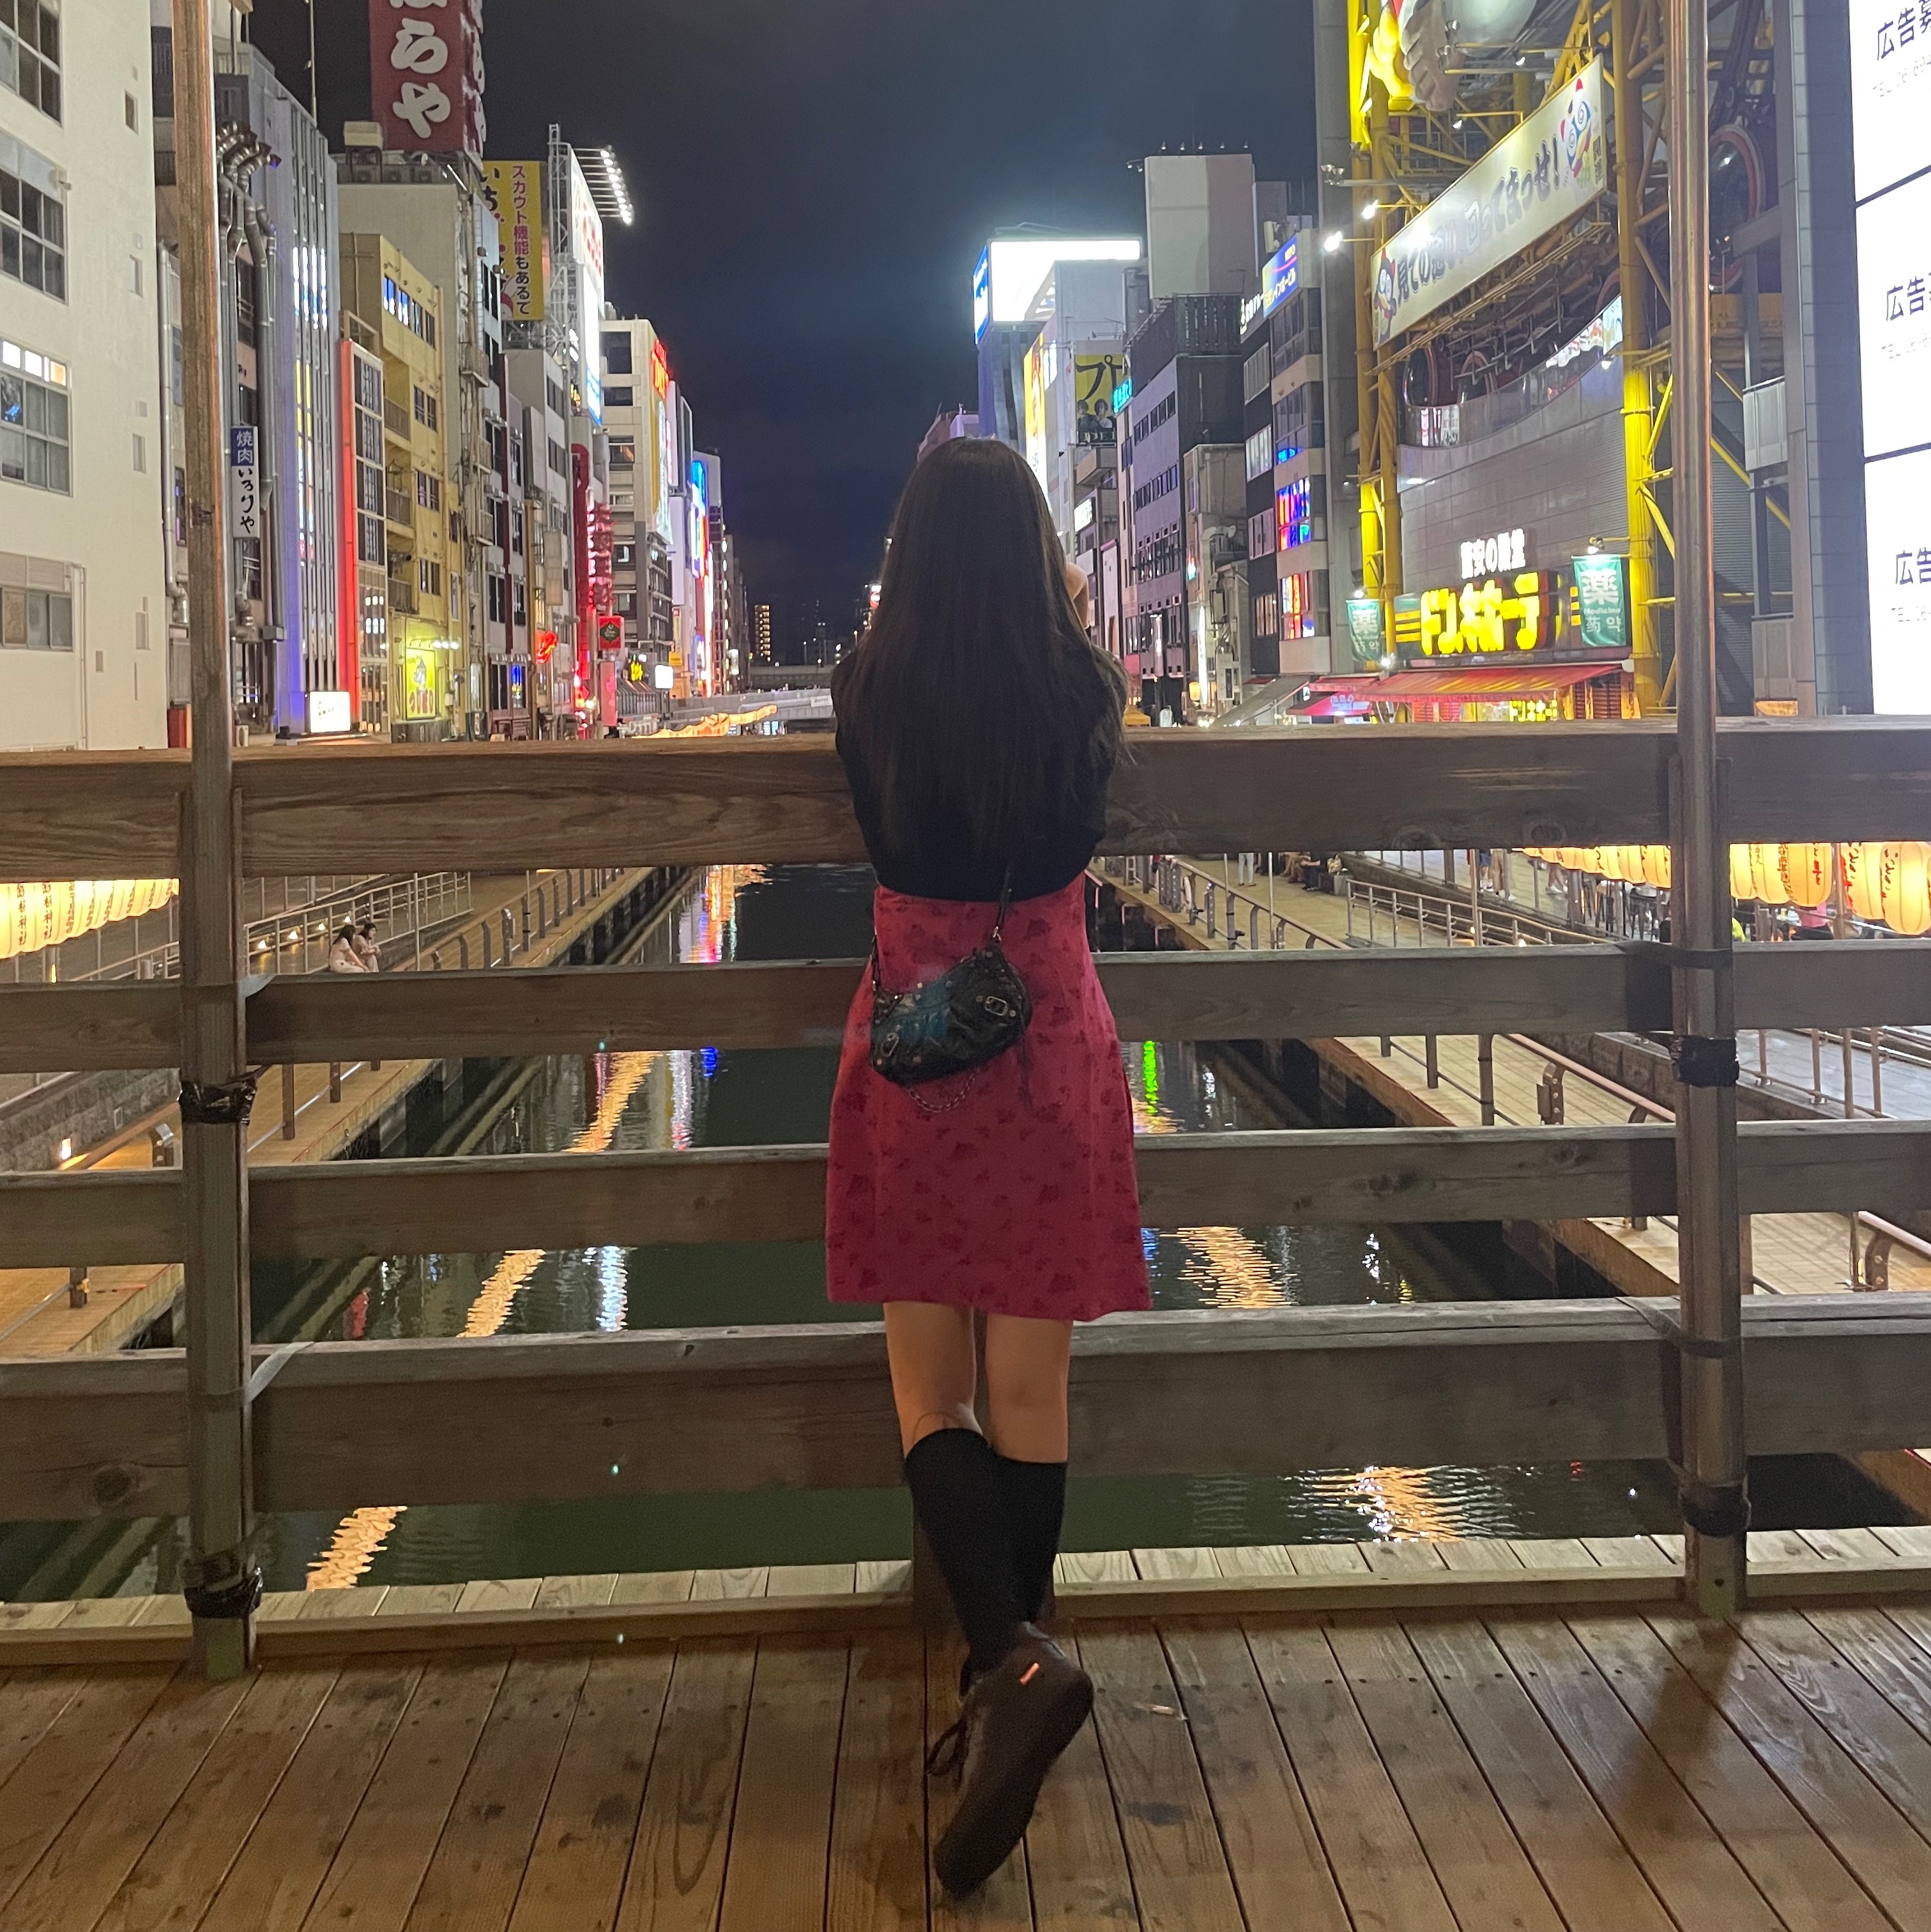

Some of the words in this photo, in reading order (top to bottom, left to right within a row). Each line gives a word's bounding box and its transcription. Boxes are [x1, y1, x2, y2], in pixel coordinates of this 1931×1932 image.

[238, 468, 255, 533] いろりや
[1580, 568, 1619, 605] 薬
